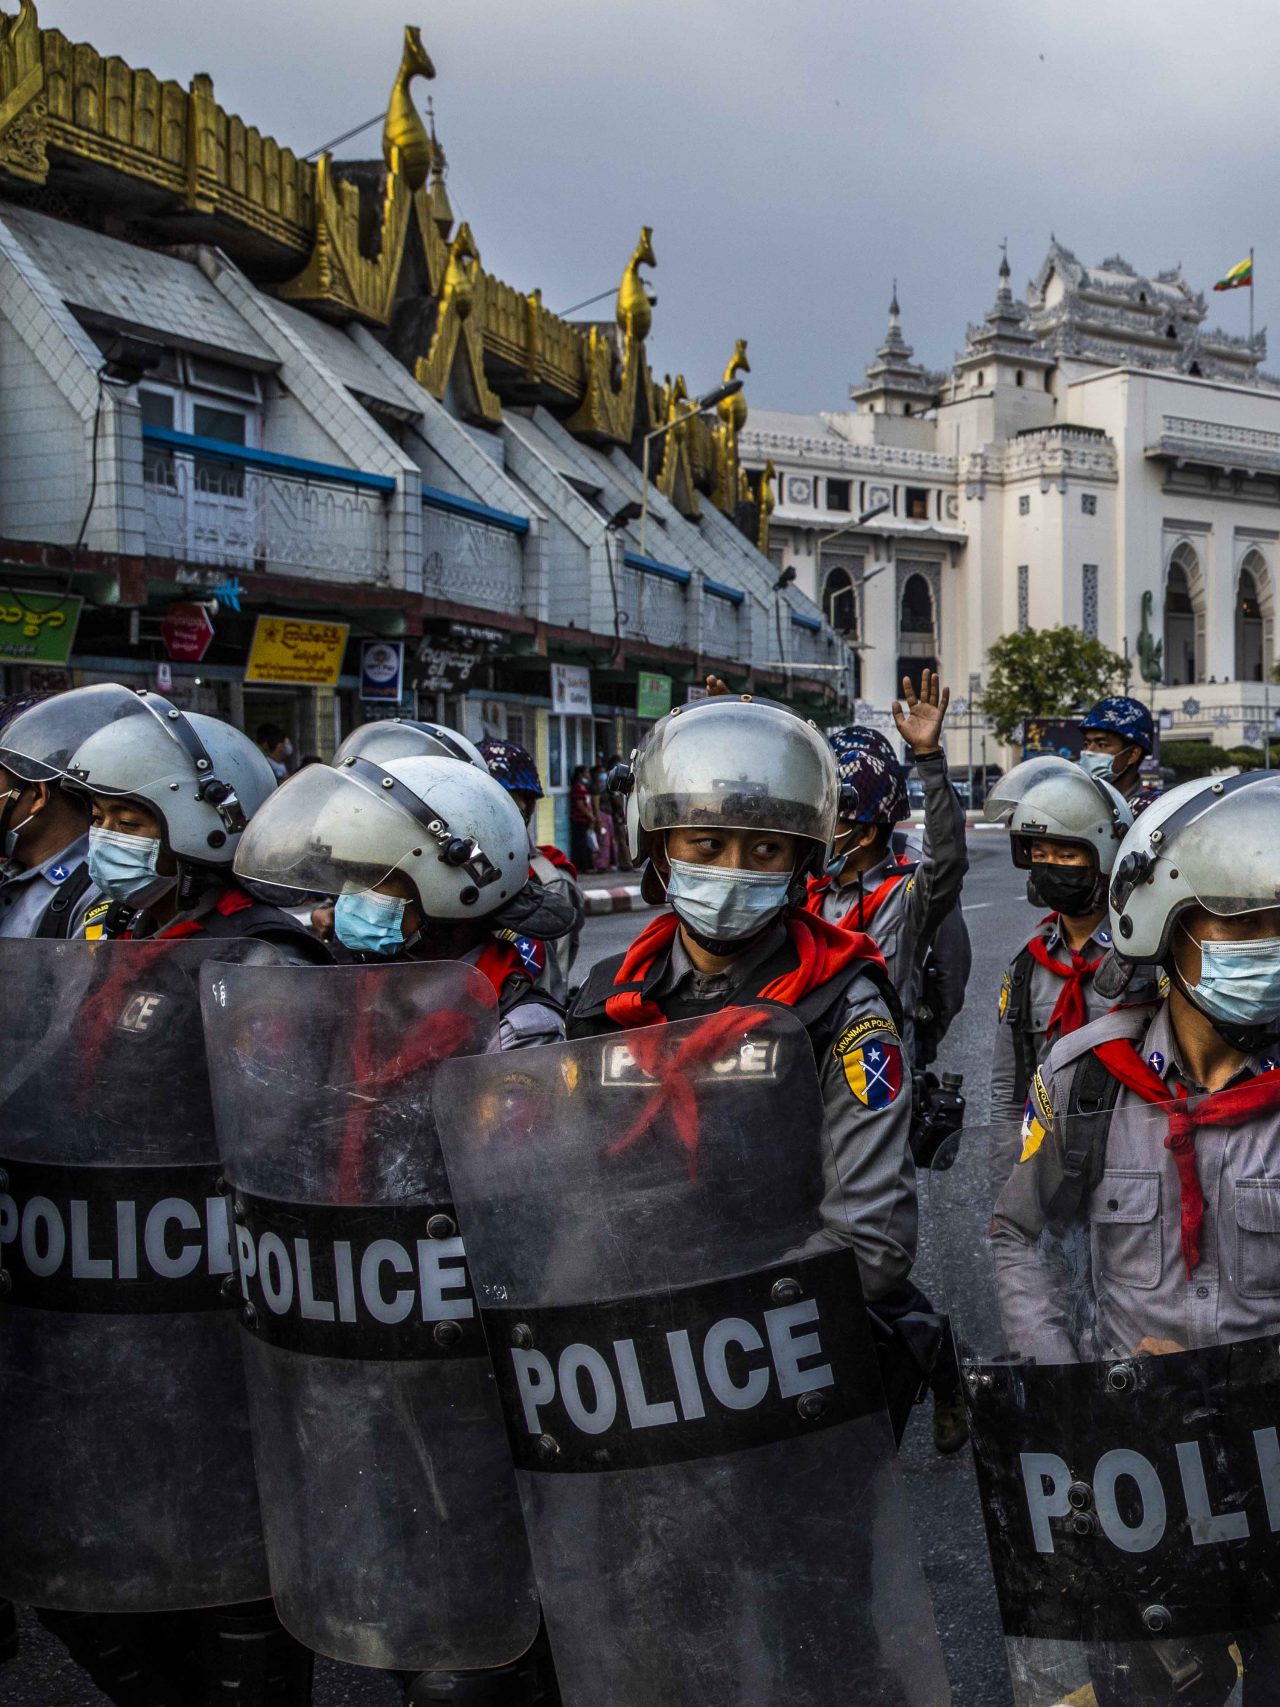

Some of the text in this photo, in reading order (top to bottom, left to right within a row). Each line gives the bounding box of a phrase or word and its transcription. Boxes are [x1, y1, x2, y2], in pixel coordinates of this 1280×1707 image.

[837, 1021, 871, 1053] MYANMAR
[1038, 1086, 1053, 1119] POLICE
[235, 1223, 474, 1325] POLICE
[510, 1298, 834, 1435] POLICE
